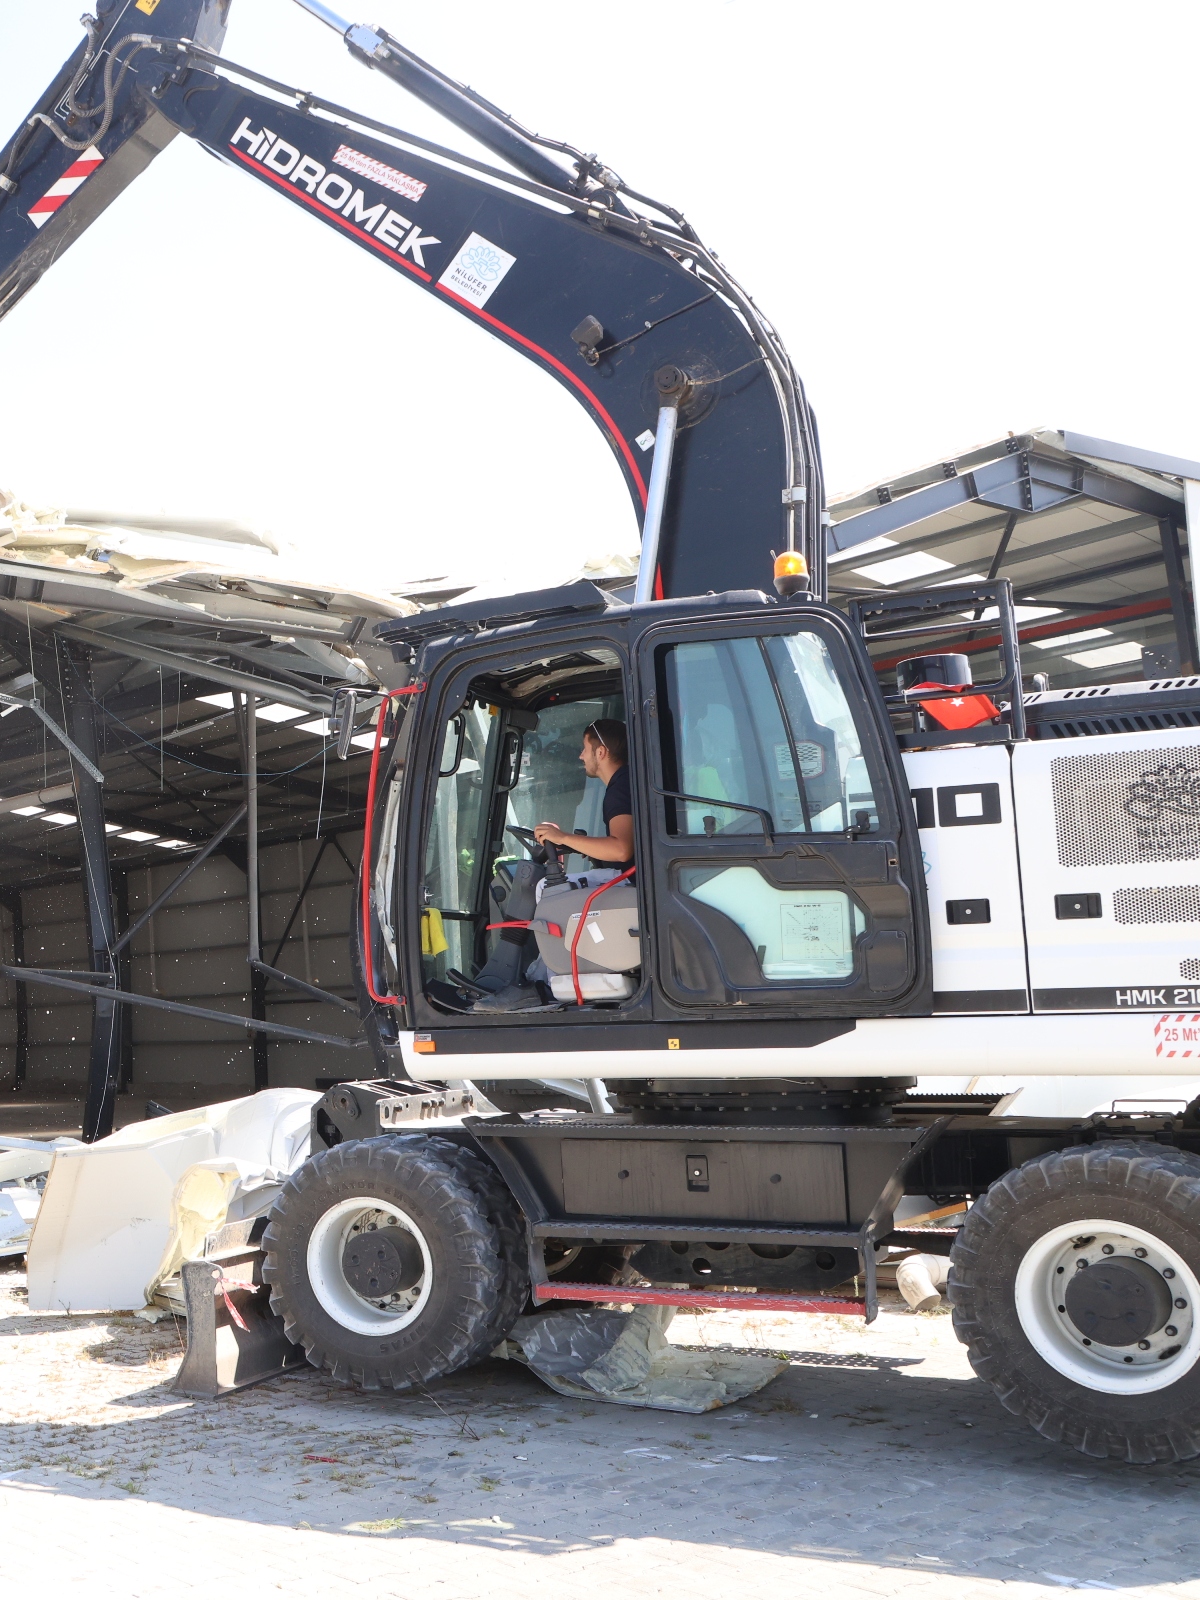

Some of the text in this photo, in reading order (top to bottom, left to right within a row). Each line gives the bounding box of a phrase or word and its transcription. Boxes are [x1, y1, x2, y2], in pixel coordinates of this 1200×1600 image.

[367, 164, 386, 178] FAZLA
[386, 173, 419, 194] YAKLAŞMA
[450, 274, 483, 297] BELEDİYESİ
[454, 267, 488, 292] NİLÜFER
[1115, 988, 1200, 1006] HMK 21
[1164, 1028, 1179, 1042] 25
